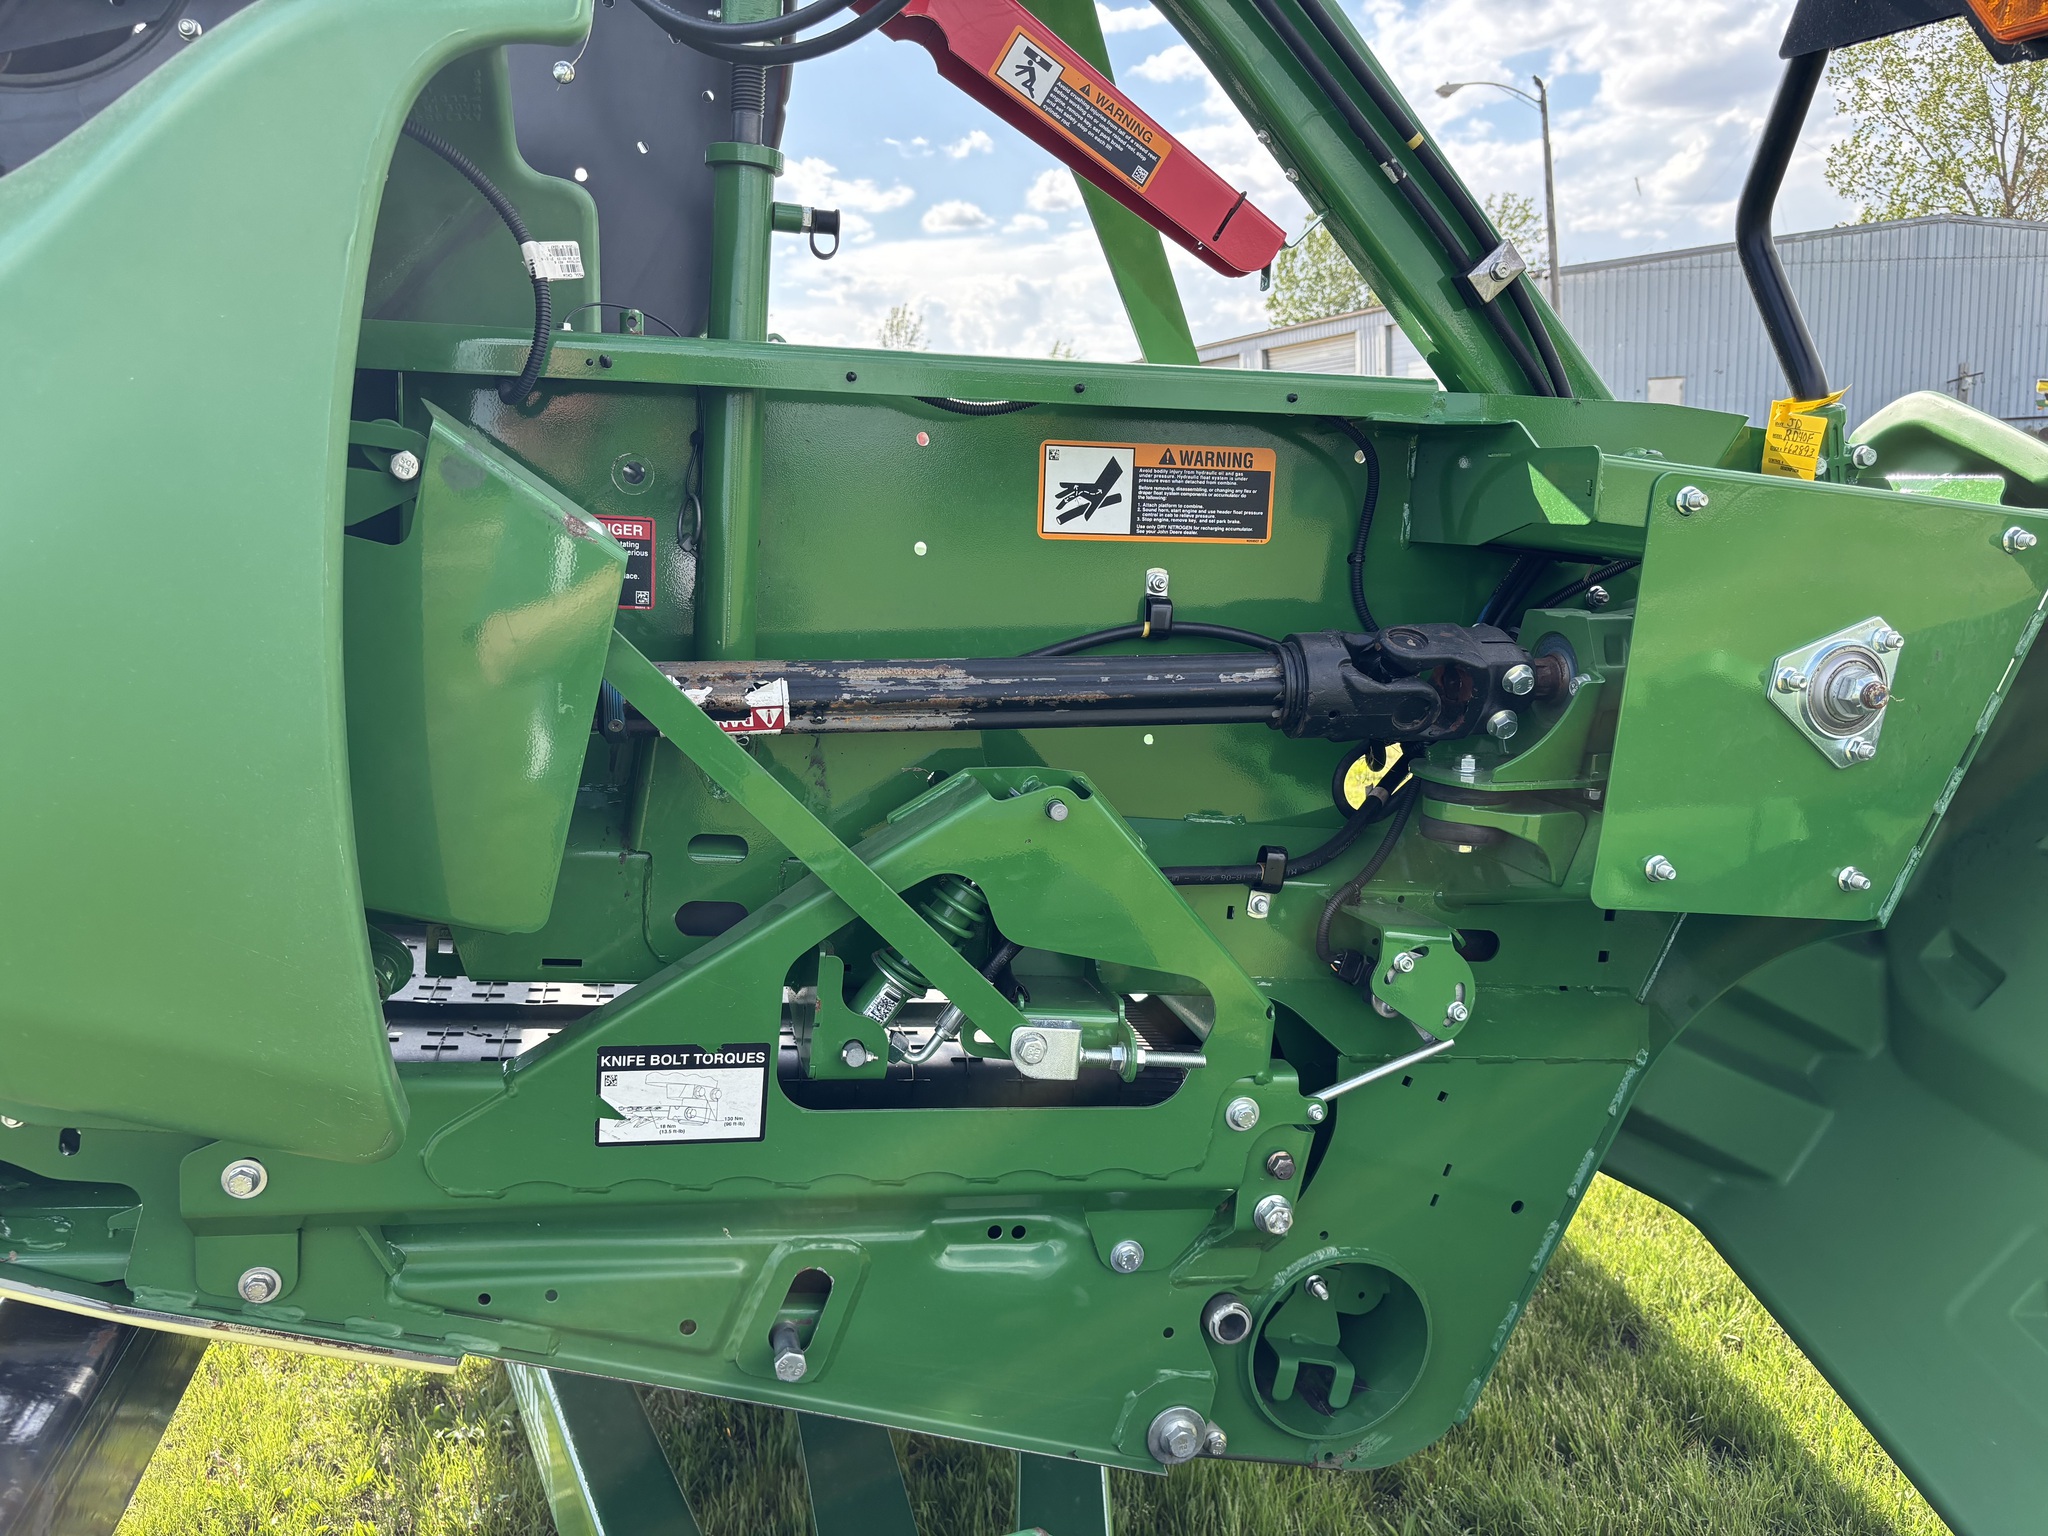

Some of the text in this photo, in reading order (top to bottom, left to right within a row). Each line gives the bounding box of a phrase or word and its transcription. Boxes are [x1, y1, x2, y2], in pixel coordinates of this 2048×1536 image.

[1043, 104, 1070, 127] cylinder rod.
[1046, 99, 1056, 107] and
[1063, 112, 1077, 124] safety
[1077, 123, 1088, 132] stop
[1094, 136, 1105, 146] each
[1050, 93, 1066, 108] engine,
[1066, 106, 1083, 120] remove
[1083, 118, 1092, 128] key,
[1099, 132, 1110, 141] park
[1110, 139, 1123, 151] brake
[1053, 87, 1069, 100] Before
[1069, 99, 1087, 115] working
[1099, 123, 1112, 134] under
[1112, 133, 1127, 145] raised
[1126, 144, 1136, 153] reel,
[1136, 152, 1146, 161] stop
[1057, 82, 1071, 93] Avoid
[1070, 92, 1090, 110] crushing
[1090, 107, 1107, 122] injuries
[1107, 120, 1118, 130] from
[1117, 128, 1126, 136] fall
[1134, 142, 1148, 154] raised
[1148, 152, 1157, 162] reel.
[1096, 92, 1153, 144] WARNING
[1180, 450, 1254, 468] WARNING
[601, 1052, 765, 1067] KNIFE BOLT TORQUES
